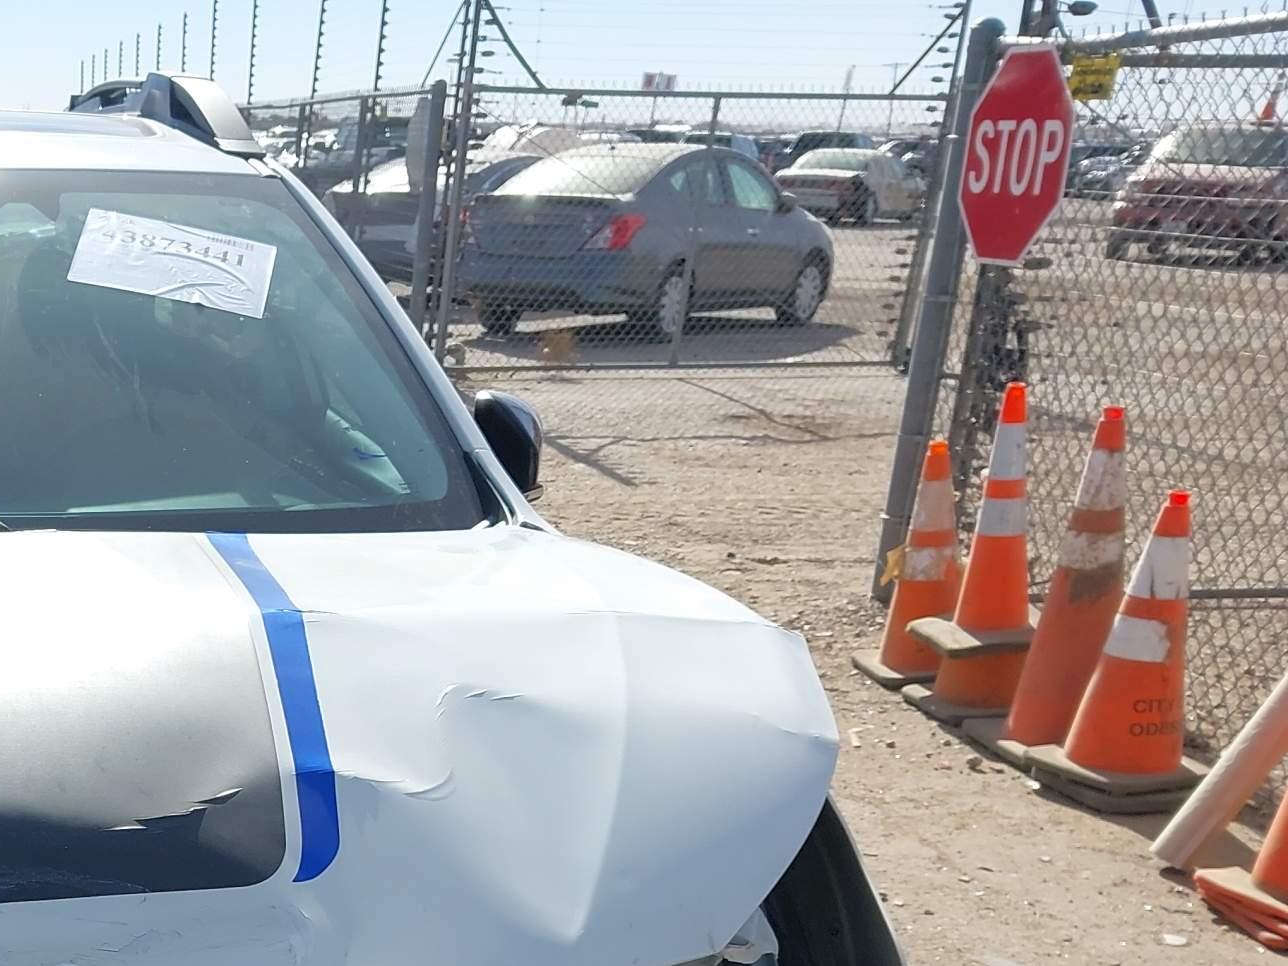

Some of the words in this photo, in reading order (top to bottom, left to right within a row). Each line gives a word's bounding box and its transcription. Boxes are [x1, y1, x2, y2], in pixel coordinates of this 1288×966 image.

[969, 118, 1064, 196] STOP
[101, 229, 246, 268] 43873441
[1132, 698, 1175, 714] CITY
